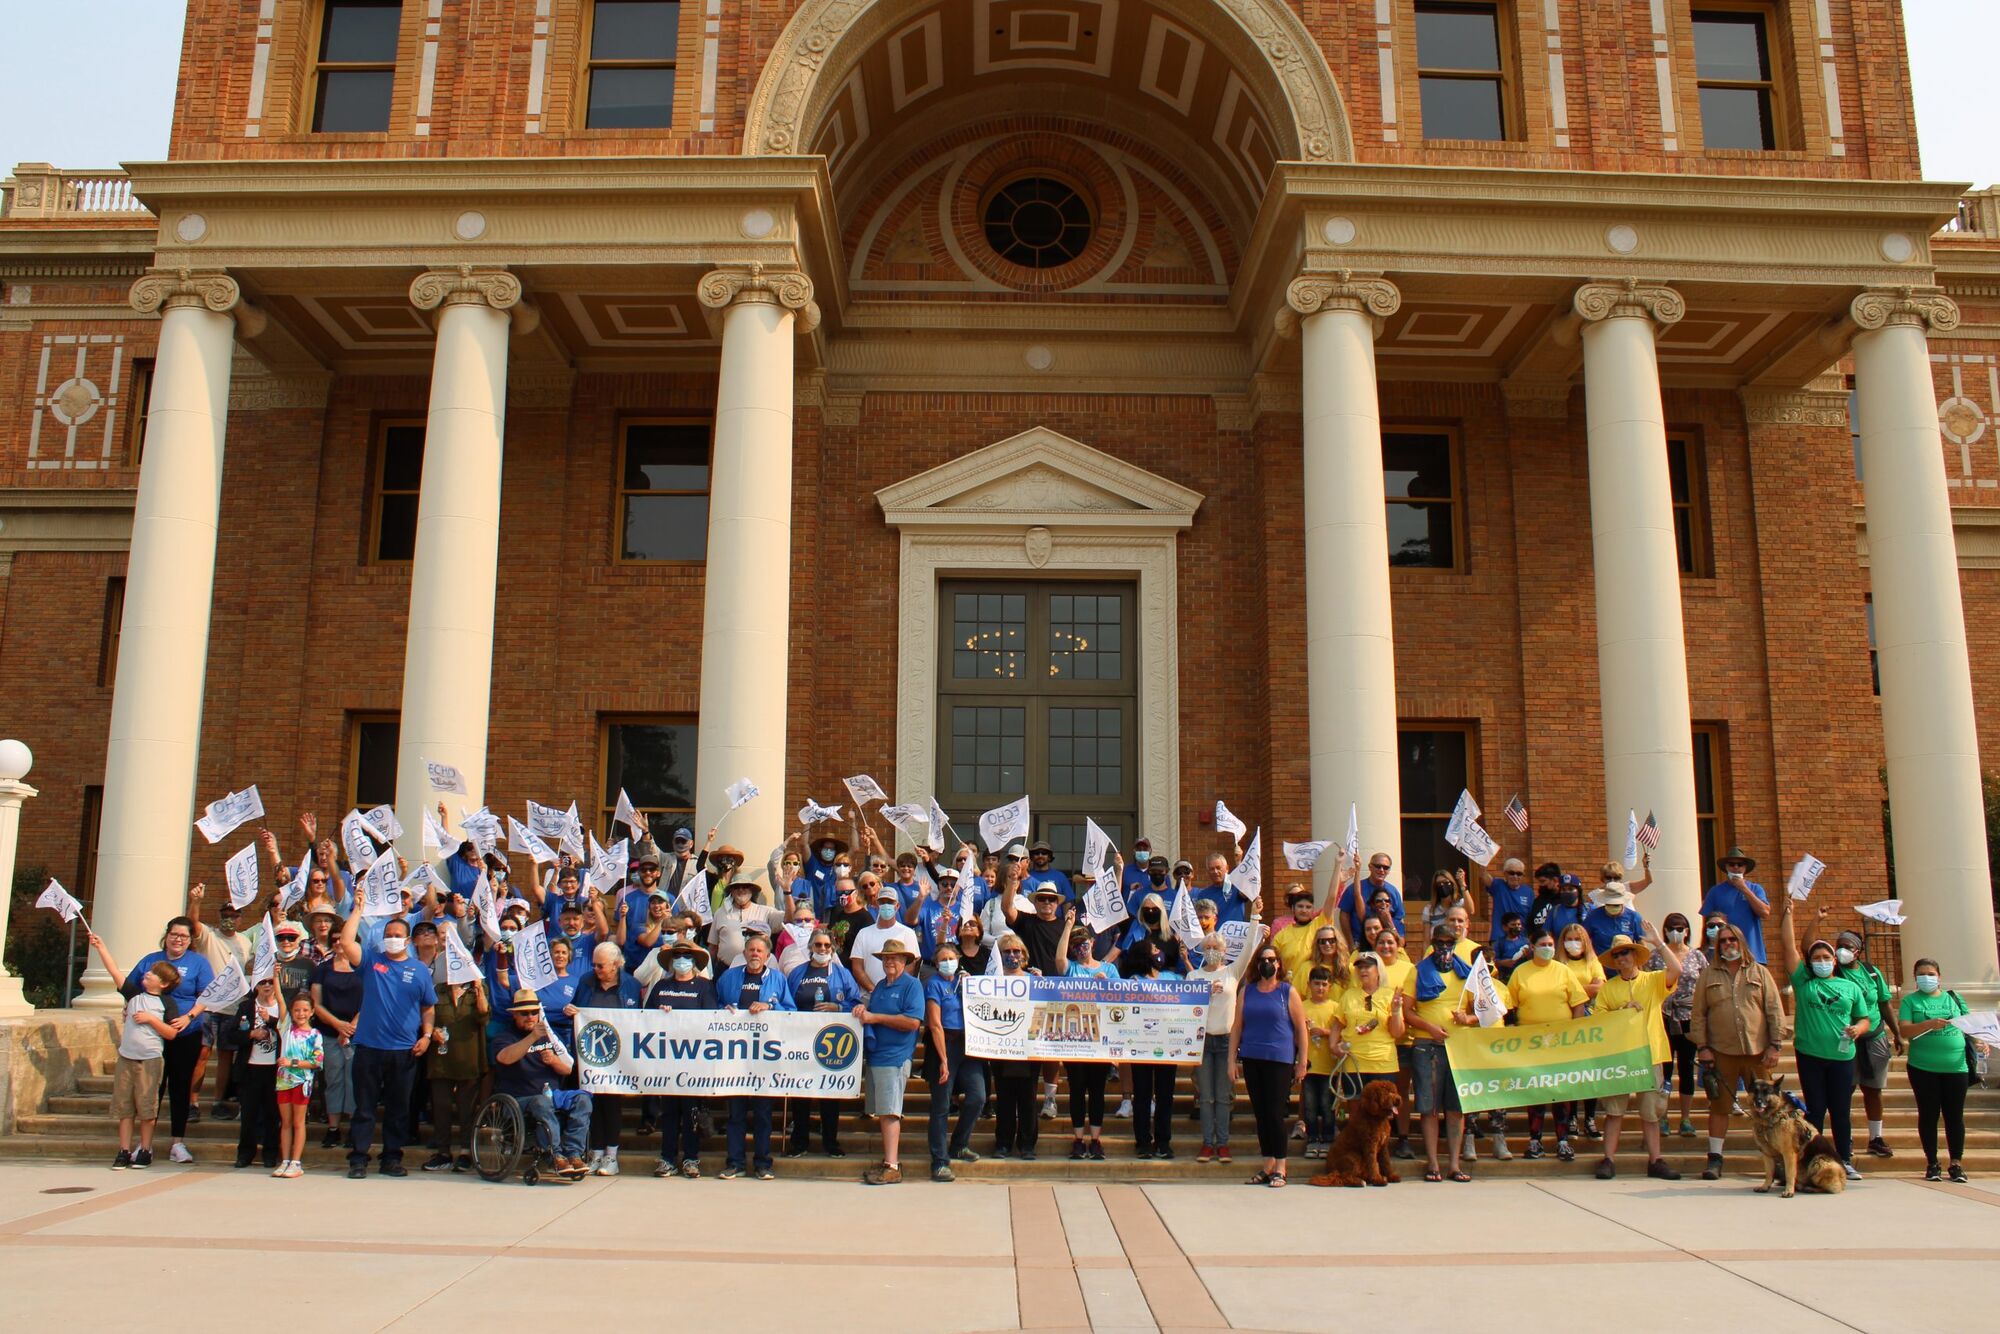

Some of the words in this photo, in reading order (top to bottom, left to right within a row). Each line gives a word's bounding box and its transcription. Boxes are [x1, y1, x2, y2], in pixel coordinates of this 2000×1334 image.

[428, 762, 456, 778] ECHO
[531, 803, 568, 817] ECHO
[380, 860, 401, 906] ECHO
[1102, 871, 1124, 914] ECHO
[533, 931, 553, 976] ECHO
[966, 977, 1027, 998] ECHO
[1033, 980, 1055, 990] 10th
[1057, 980, 1104, 991] ANNUAL
[1108, 982, 1139, 992] LONG
[1141, 983, 1173, 993] WALK
[1175, 984, 1208, 993] HOME
[1061, 991, 1096, 1001] THANK
[1101, 992, 1120, 1001] YOU
[1124, 993, 1180, 1003] SPONSORS
[708, 1022, 769, 1032] ATASCADERO
[592, 1031, 609, 1056] K
[817, 1032, 854, 1059] 50
[1489, 1035, 1522, 1055] GO
[1528, 1026, 1604, 1051] SOLAR
[1008, 1048, 1025, 1056] Years
[825, 1058, 843, 1066] YEARS
[581, 1069, 639, 1090] Serving
[643, 1075, 671, 1088] our
[675, 1071, 765, 1091] Community
[769, 1072, 813, 1089] Since
[818, 1073, 856, 1091] 1969
[1457, 1081, 1484, 1097] GO
